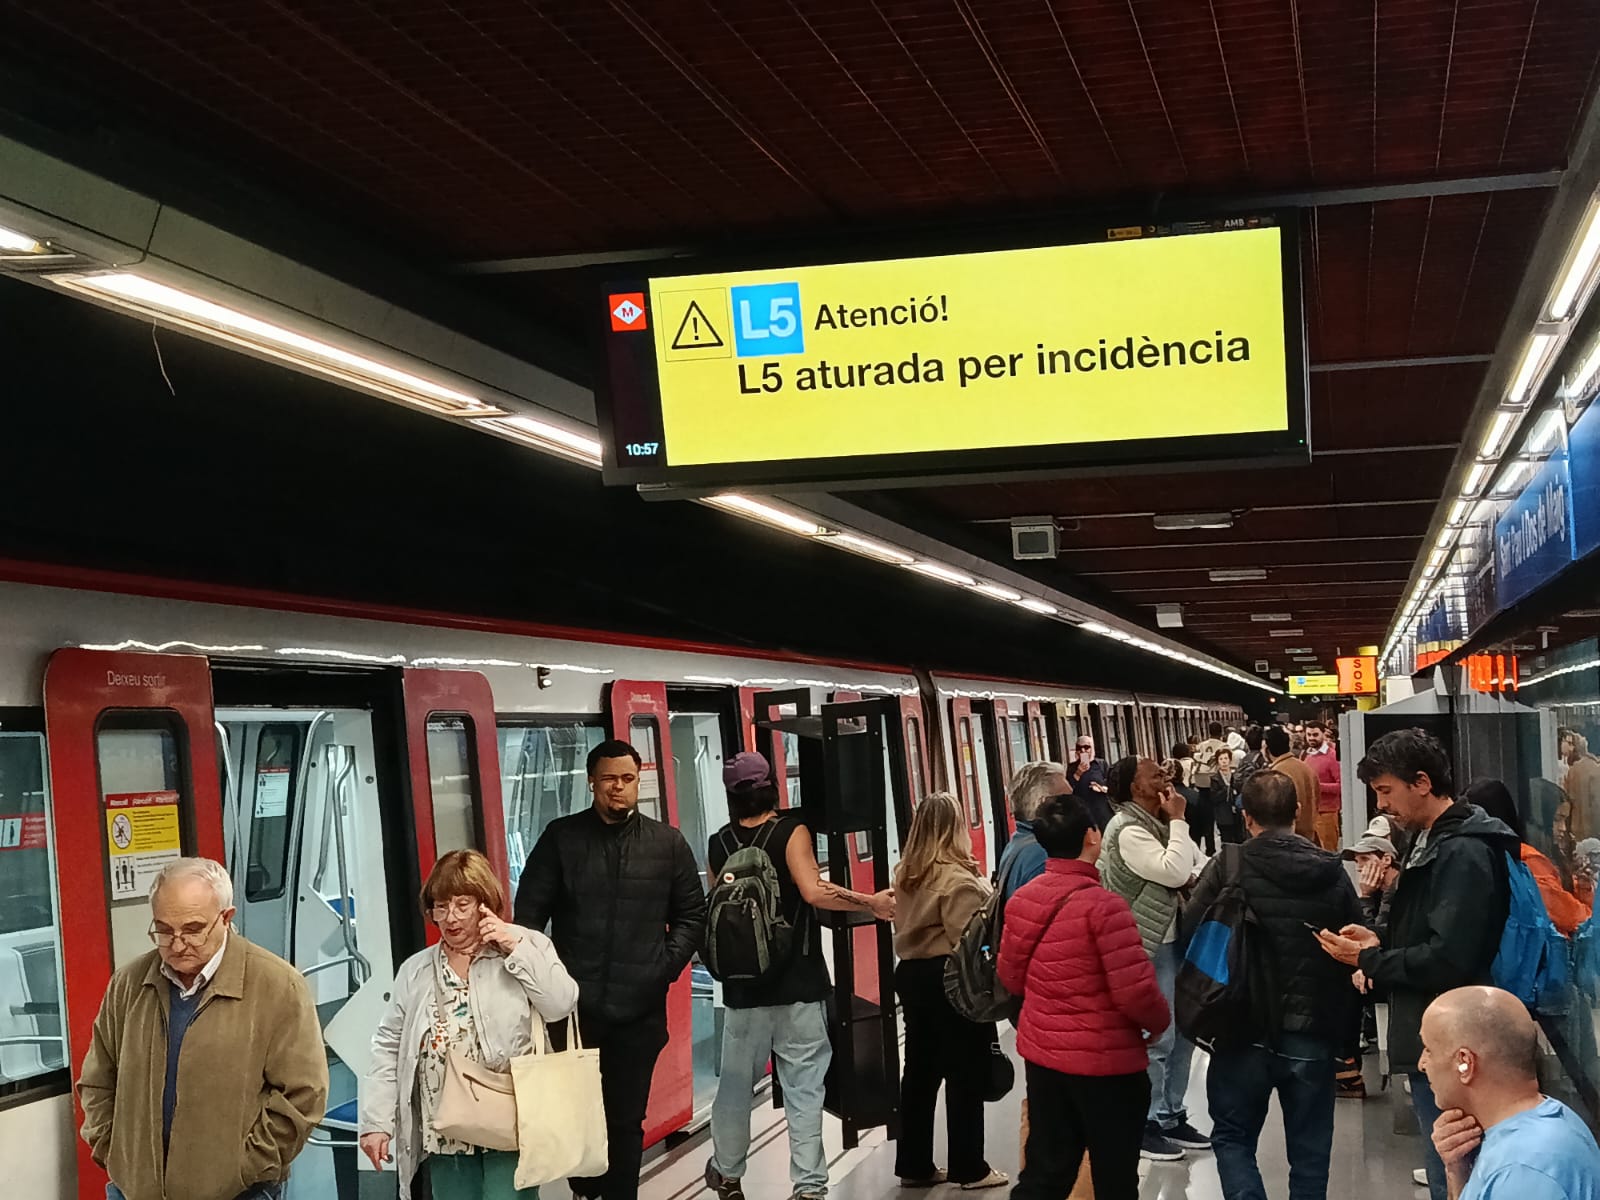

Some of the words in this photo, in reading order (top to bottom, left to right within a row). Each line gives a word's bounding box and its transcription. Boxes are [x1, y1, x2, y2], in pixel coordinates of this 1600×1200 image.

[1223, 218, 1245, 228] AMB
[621, 307, 634, 318] M
[739, 296, 798, 341] L5
[814, 294, 948, 331] Atenció!
[738, 362, 783, 395] L5
[796, 352, 945, 391] aturada
[958, 352, 1024, 388] per
[1036, 330, 1250, 376] incidència
[625, 442, 659, 456] 10:57
[107, 670, 141, 686] Deixeu
[1353, 659, 1363, 692] SOS
